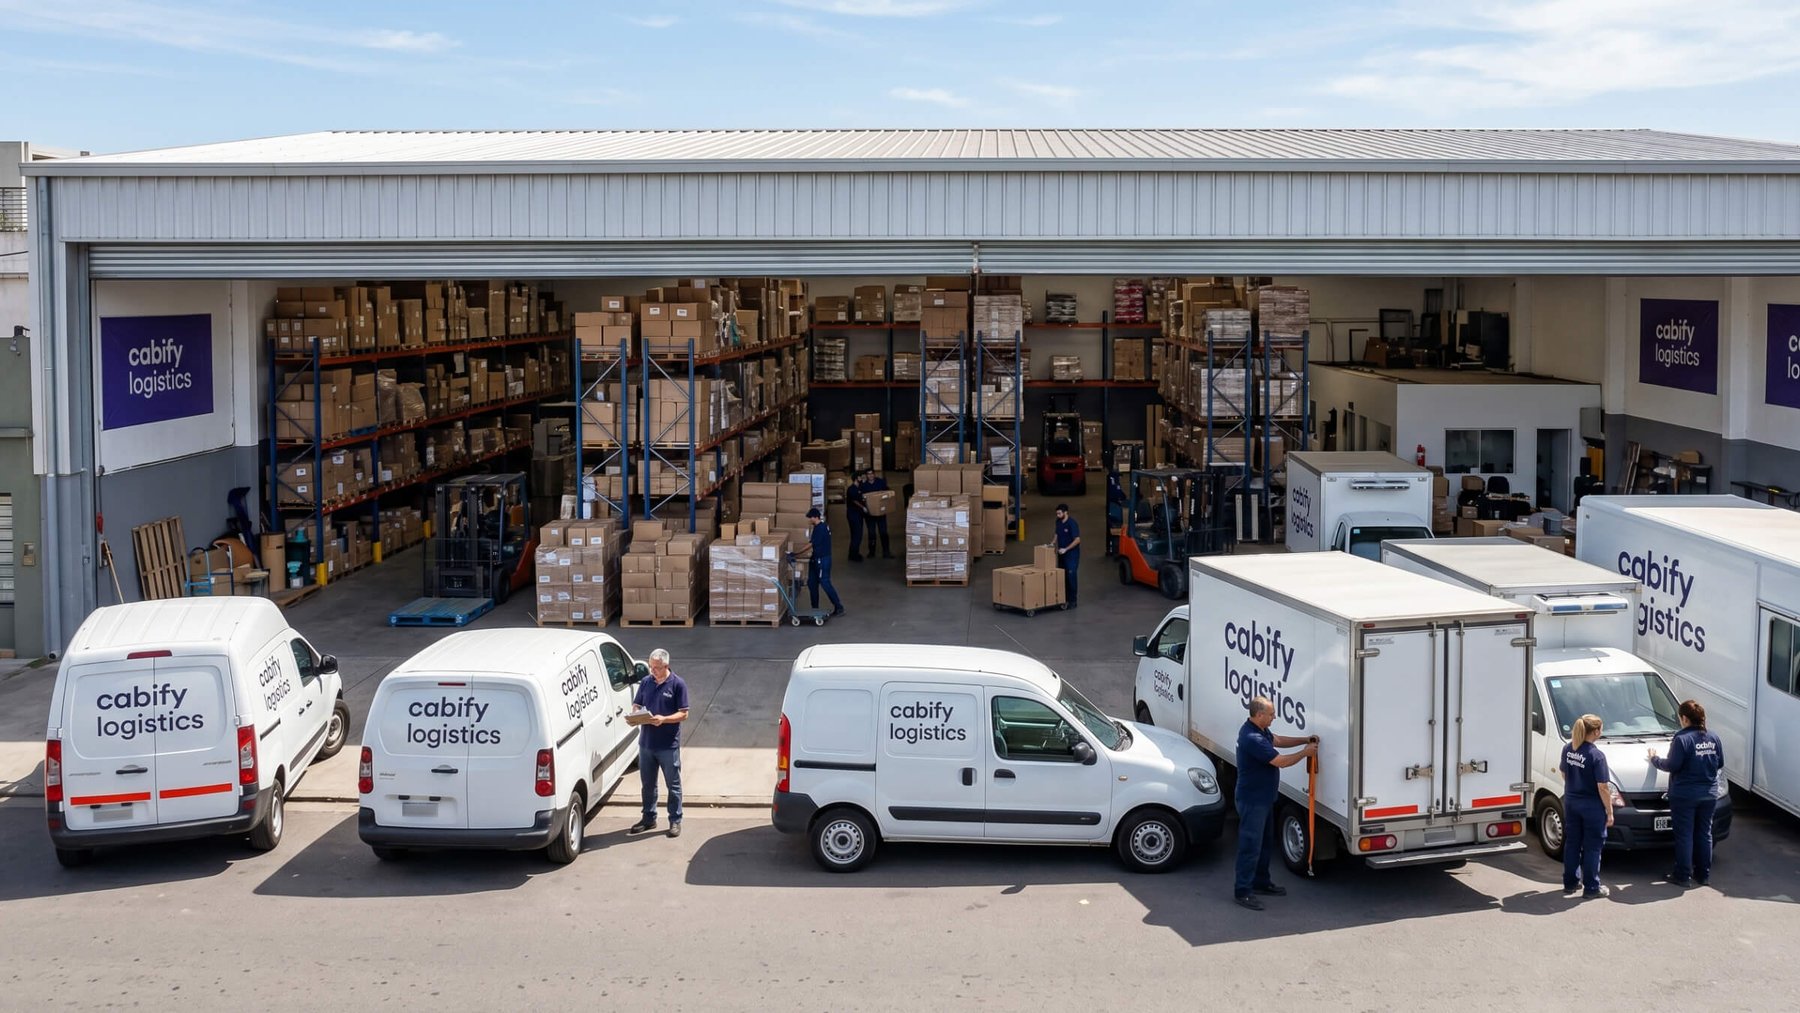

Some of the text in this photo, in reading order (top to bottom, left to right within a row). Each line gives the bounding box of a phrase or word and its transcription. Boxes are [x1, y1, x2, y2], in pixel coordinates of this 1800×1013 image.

[1655, 318, 1695, 346] cabify
[128, 338, 183, 368] cabify
[1655, 343, 1700, 368] logistics
[129, 368, 192, 399] logistics
[1292, 486, 1312, 517] cabify
[1618, 550, 1694, 608] cabify
[1638, 596, 1706, 653] gistics
[1224, 620, 1295, 683] cabify
[259, 655, 282, 687] cabify
[561, 663, 589, 696] cabify
[96, 683, 188, 710] cabify
[264, 679, 291, 712] logistics
[408, 697, 489, 723] cabify
[566, 685, 599, 720] logistics
[97, 711, 204, 740] logistics
[890, 701, 954, 723] cabify
[407, 723, 501, 748] logistics
[890, 722, 966, 744] logistics
